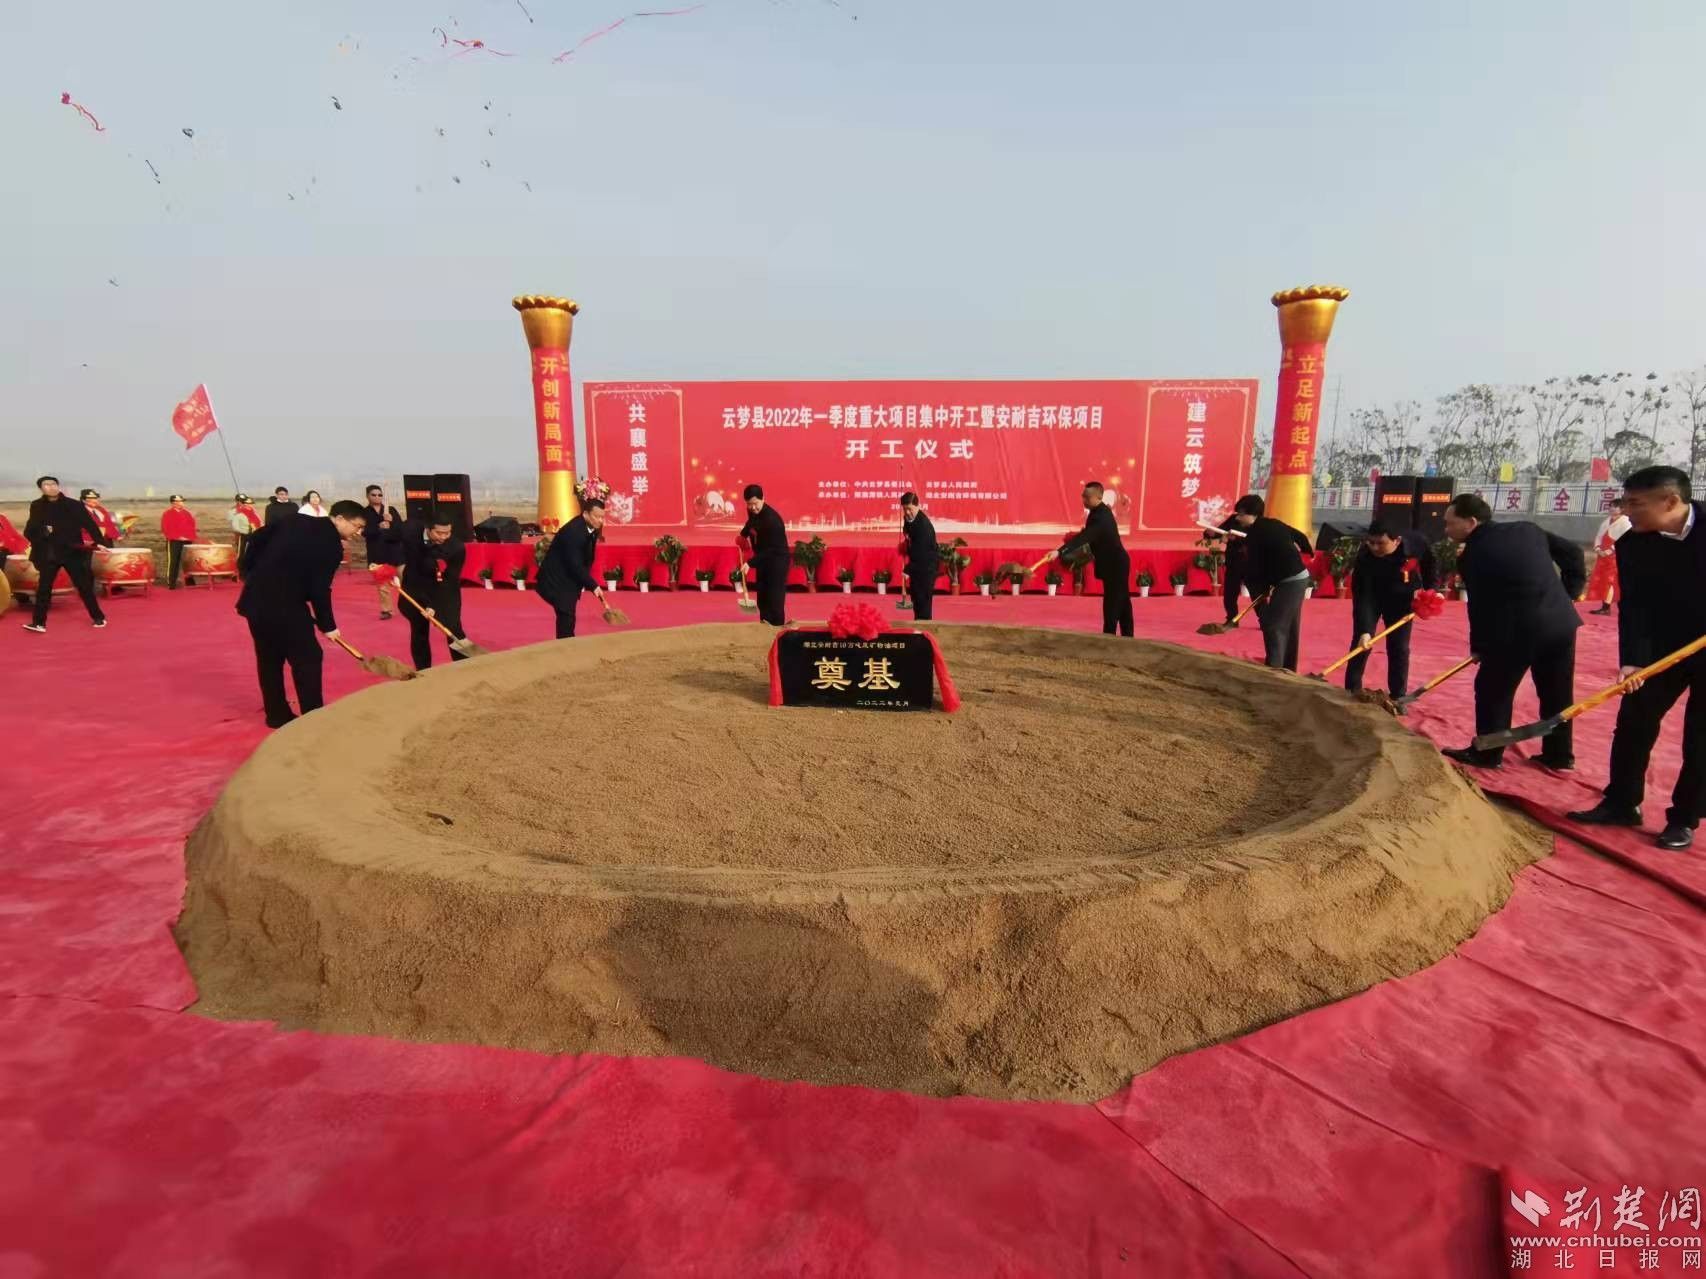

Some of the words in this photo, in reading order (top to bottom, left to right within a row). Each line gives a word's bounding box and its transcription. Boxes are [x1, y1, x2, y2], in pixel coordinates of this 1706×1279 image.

[540, 356, 563, 463] 开创新局面
[629, 403, 648, 495] 共襄盛举
[722, 405, 1103, 429] 云梦县2022年一季度重大项目集中开工暨安耐吉环保项目
[845, 439, 974, 459] 开工仪式
[1181, 401, 1207, 498] 建云筑梦
[1288, 355, 1317, 468] 立足新起点
[811, 656, 900, 691] 奠基
